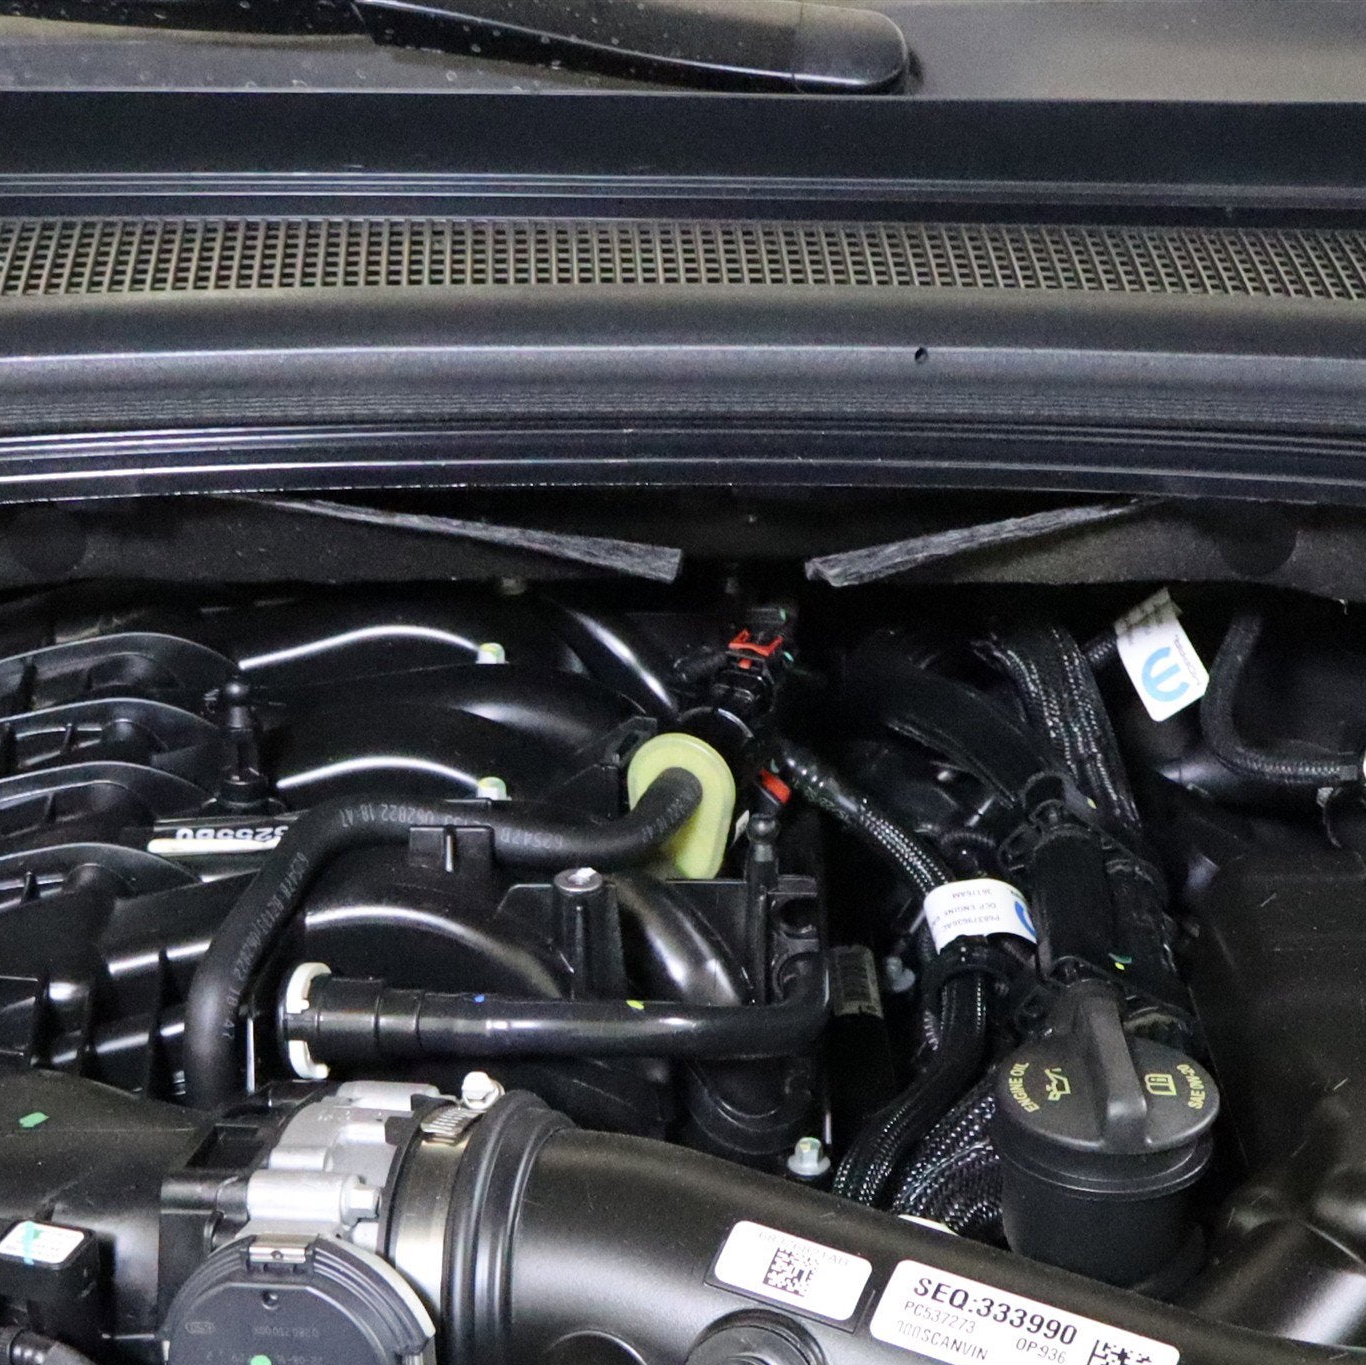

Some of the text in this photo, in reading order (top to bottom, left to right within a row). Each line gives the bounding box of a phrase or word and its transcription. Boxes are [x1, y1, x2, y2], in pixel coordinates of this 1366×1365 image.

[1008, 1062, 1040, 1113] ENGINE OIL
[1187, 1089, 1206, 1110] SAE
[904, 1300, 977, 1335] PC537273
[913, 1277, 1078, 1346] SEQ:333990
